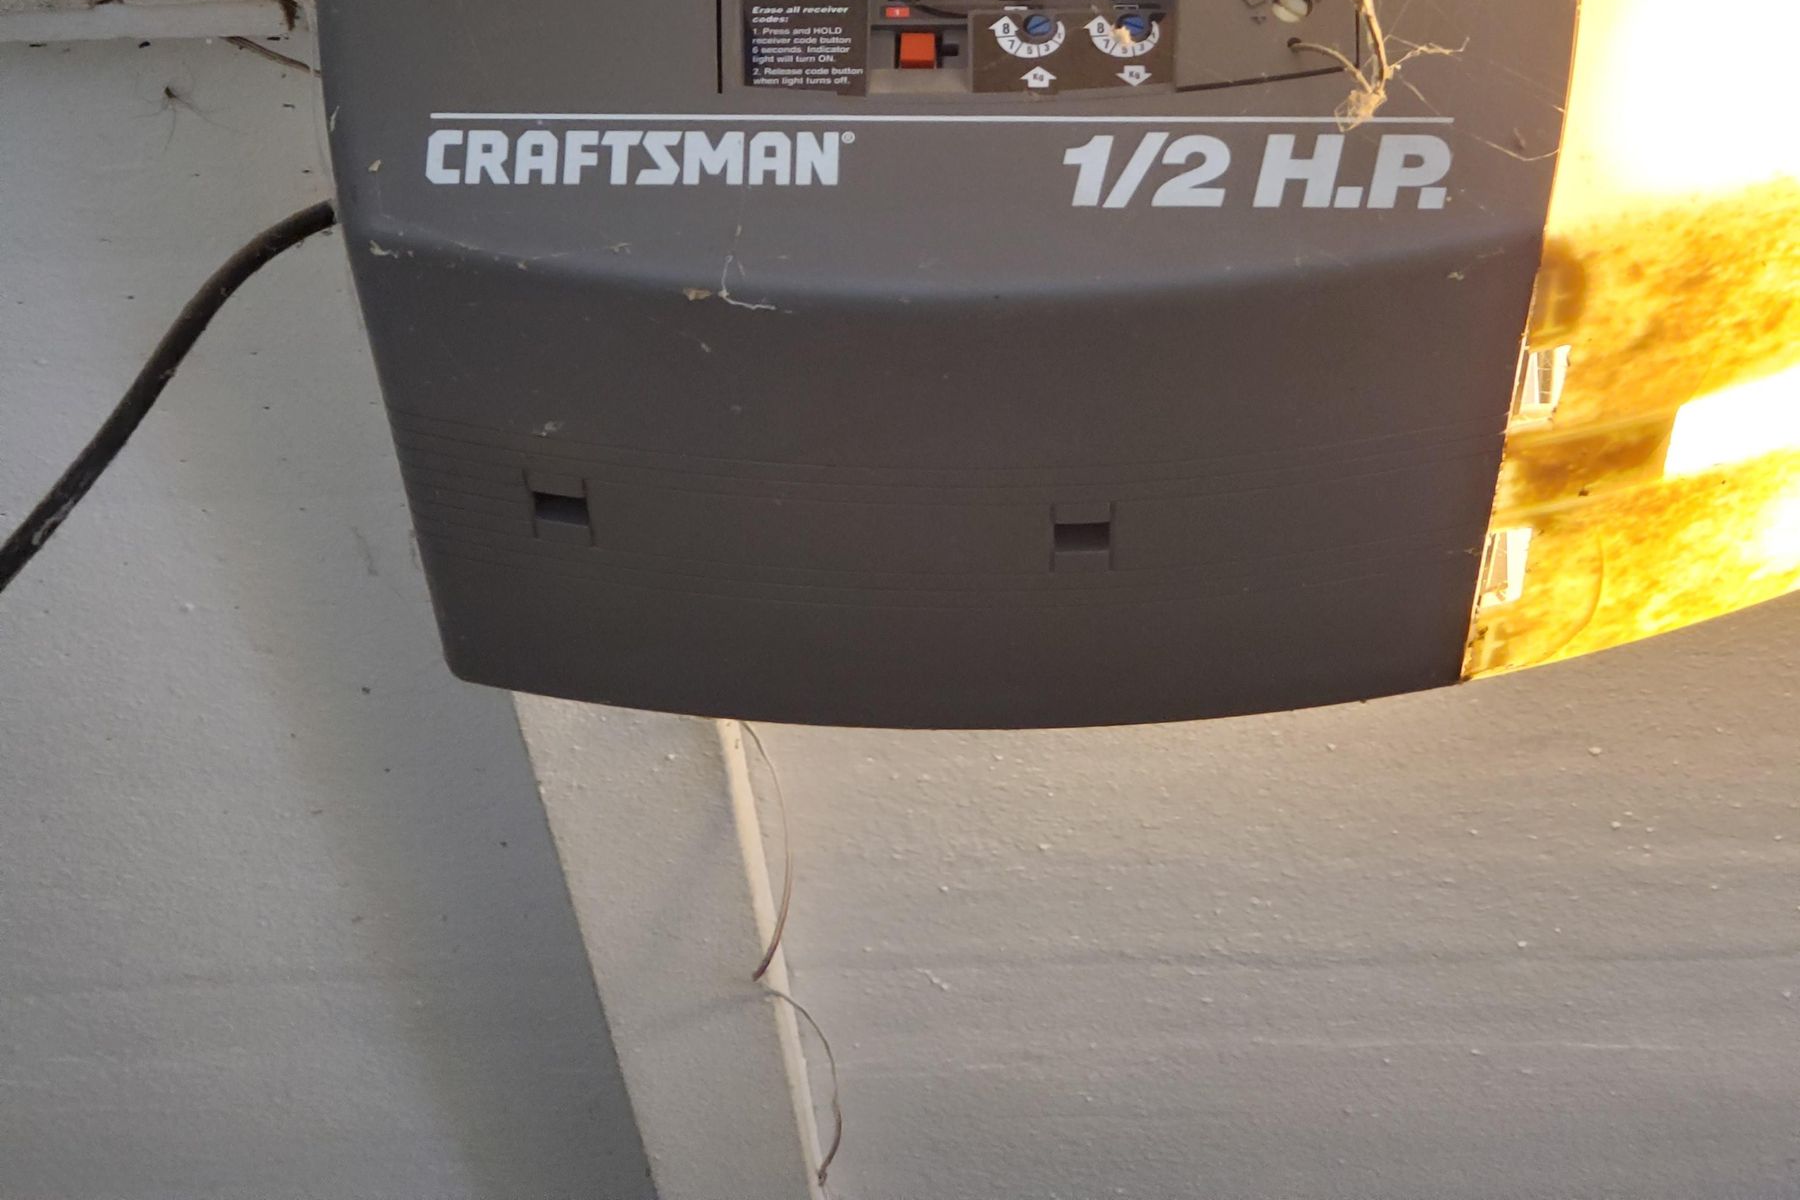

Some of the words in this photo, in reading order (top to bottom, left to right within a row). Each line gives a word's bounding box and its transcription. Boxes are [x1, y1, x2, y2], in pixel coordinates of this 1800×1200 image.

[752, 6, 783, 14] Erase
[762, 27, 790, 35] Press
[793, 27, 811, 35] and
[813, 27, 842, 35] HOLD
[1002, 23, 1010, 34] 8
[1097, 22, 1104, 34] 8
[1008, 39, 1015, 49] 7
[1103, 39, 1110, 48] 7
[752, 55, 774, 64] light
[764, 68, 802, 76] Release
[781, 77, 803, 86] light
[834, 76, 850, 84] off.
[1062, 131, 1232, 209] 1/2
[1252, 133, 1452, 210] H.P.
